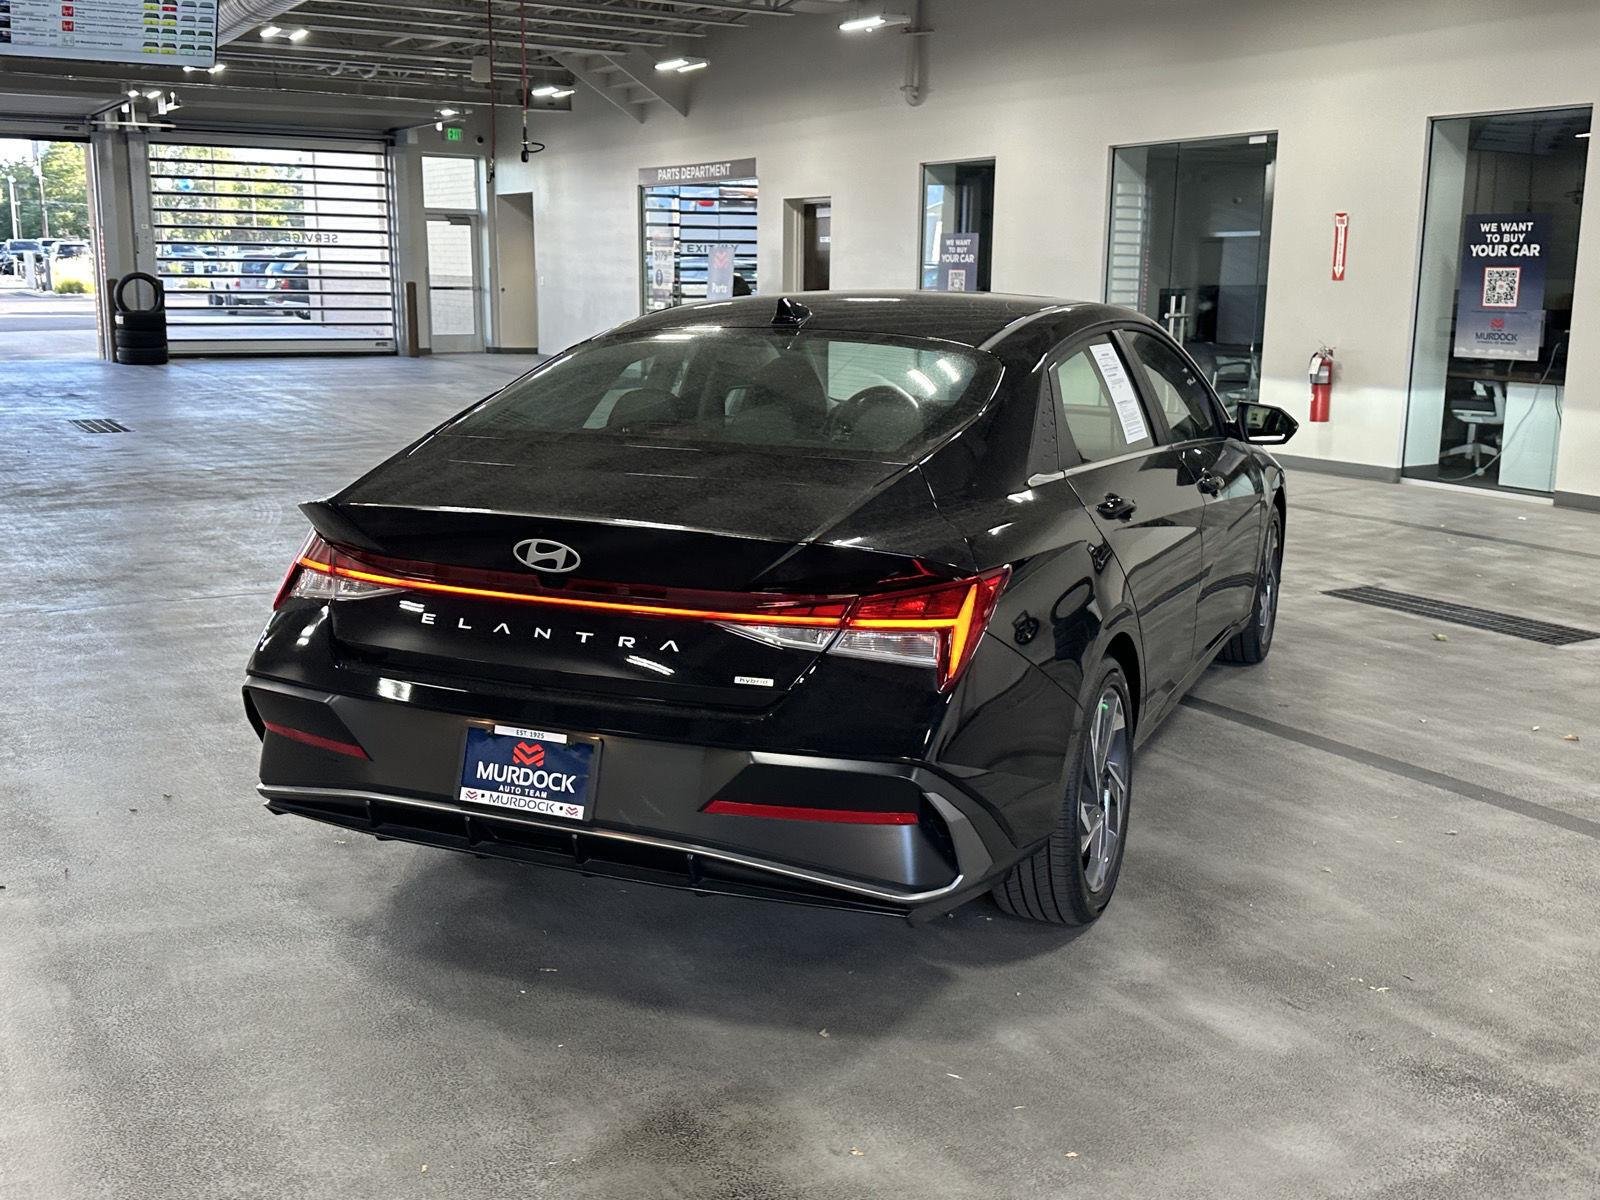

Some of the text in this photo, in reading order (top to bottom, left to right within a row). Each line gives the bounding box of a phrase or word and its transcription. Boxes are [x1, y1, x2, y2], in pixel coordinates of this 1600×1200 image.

[658, 164, 731, 180] PARTS DEPARTMENT
[1480, 222, 1534, 232] WE WANT
[1485, 233, 1526, 243] TO BUY
[1470, 244, 1540, 257] YOUR CAR
[941, 254, 975, 263] YOUR CAR
[1475, 332, 1519, 342] MURDOCK
[421, 612, 680, 653] ELANTRA
[530, 731, 545, 739] 1925
[476, 761, 577, 794] MURDOCK
[498, 784, 548, 799] AUTO TEAM
[489, 793, 555, 813] MURDOCK
